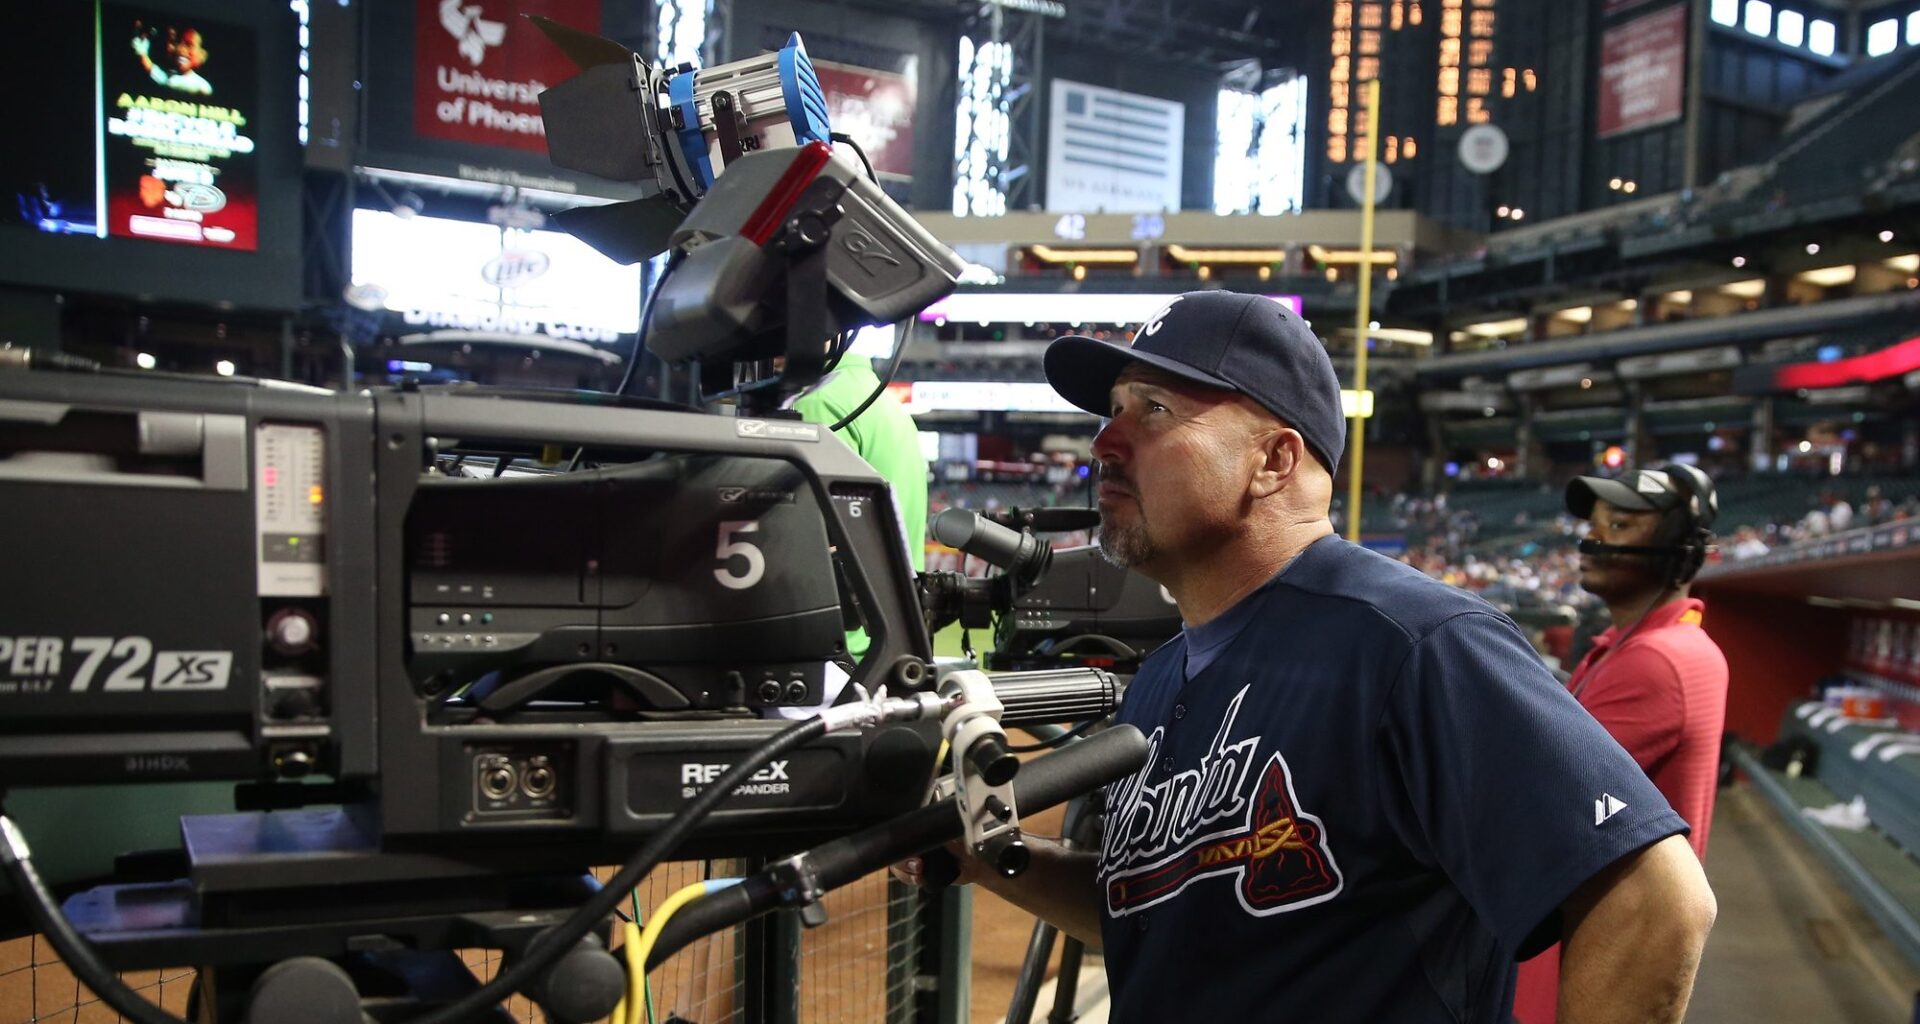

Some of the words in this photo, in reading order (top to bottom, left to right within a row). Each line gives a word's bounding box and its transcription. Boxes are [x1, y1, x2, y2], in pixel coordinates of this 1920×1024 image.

[436, 97, 466, 124] of
[1054, 213, 1086, 240] 42
[848, 501, 862, 518] 6
[713, 520, 766, 590] 5
[69, 635, 153, 692] 72
[681, 760, 789, 784] REEX
